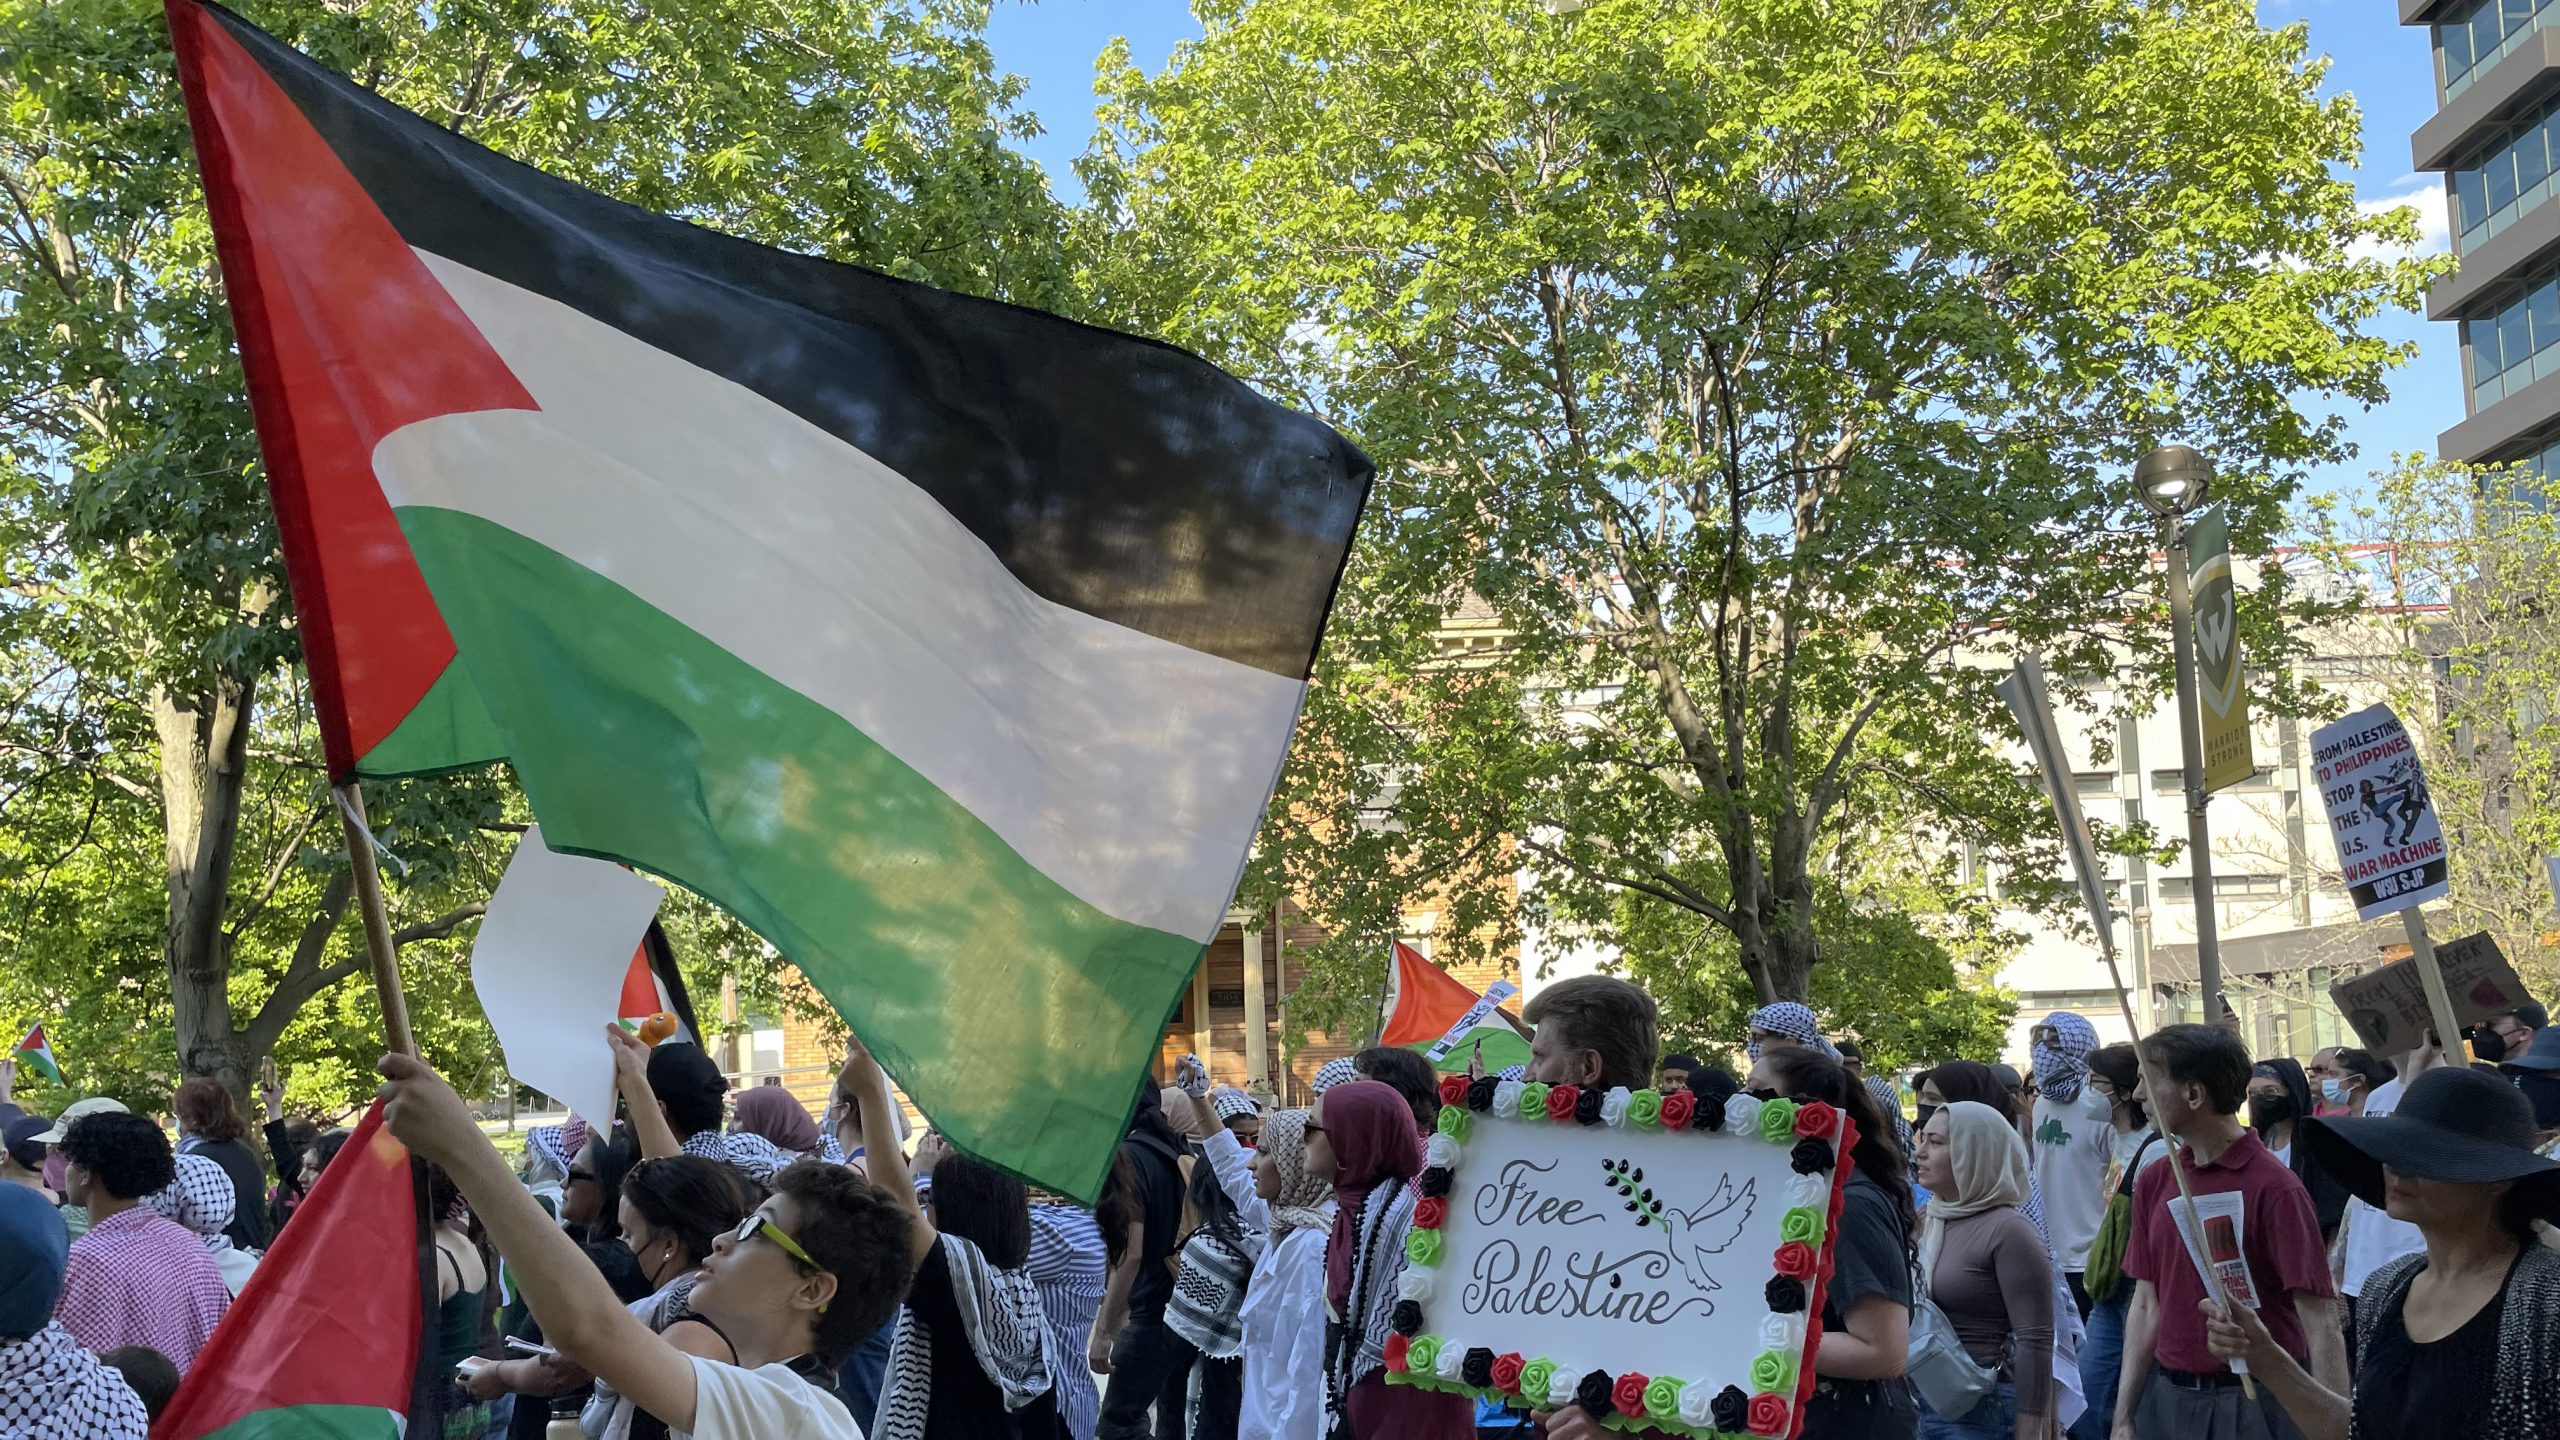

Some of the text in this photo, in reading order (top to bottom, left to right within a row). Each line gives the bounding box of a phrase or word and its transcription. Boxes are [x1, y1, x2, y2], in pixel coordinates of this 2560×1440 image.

[2206, 726, 2245, 754] WARRIOR
[2211, 744, 2245, 767] STRONG
[2315, 718, 2402, 765] FROM PALESTINE
[2318, 765, 2331, 783] TO
[2335, 735, 2410, 778] PHILIPPINES
[2325, 783, 2355, 807] STOP
[2334, 810, 2361, 832] THE
[2342, 837, 2368, 856] U.S.
[2344, 836, 2443, 882] WAR MACHINE
[2373, 867, 2425, 899] WSU SJP
[1474, 1157, 1606, 1226] Free
[1462, 1238, 1715, 1325] Palestine
